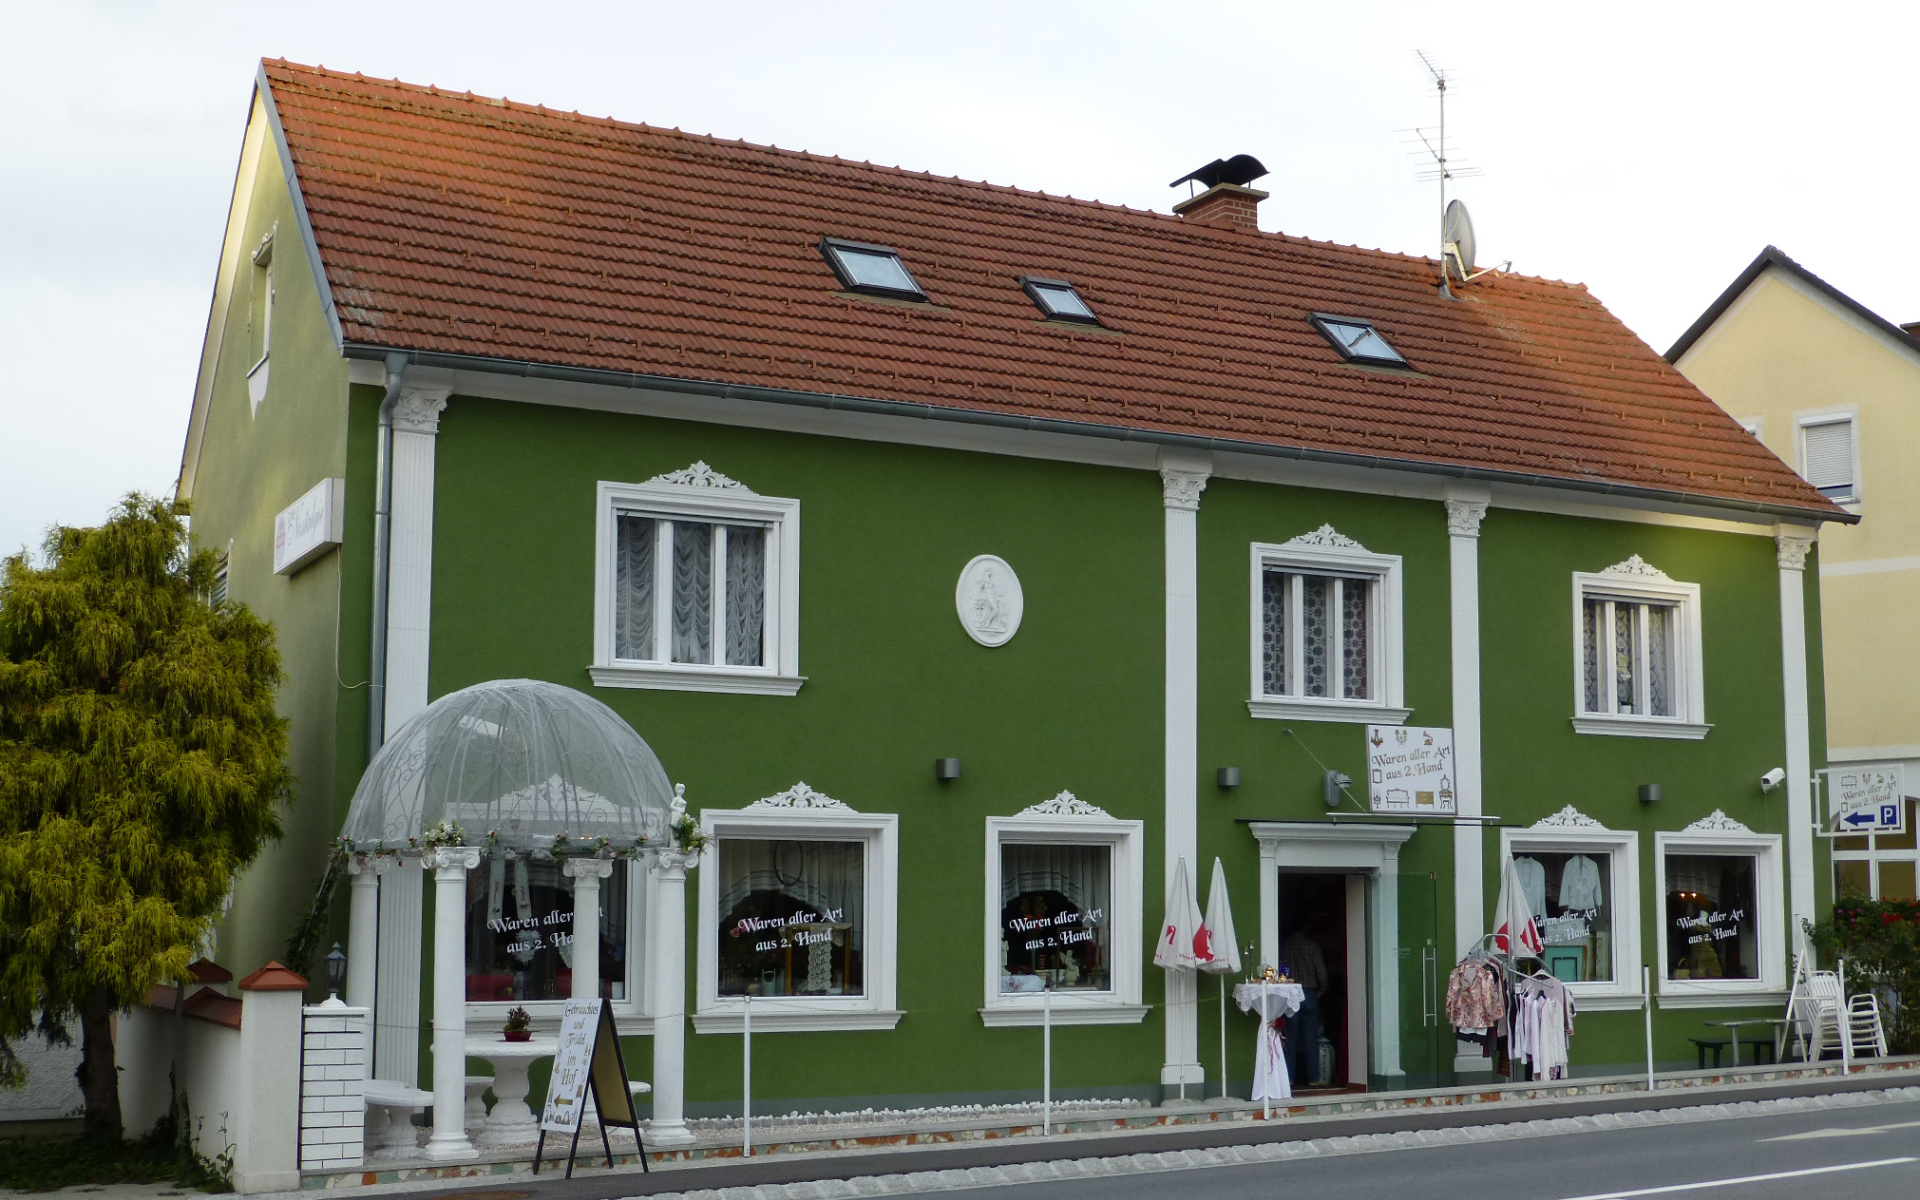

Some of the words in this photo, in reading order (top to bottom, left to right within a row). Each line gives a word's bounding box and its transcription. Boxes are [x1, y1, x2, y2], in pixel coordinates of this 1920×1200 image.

[1371, 754, 1408, 767] Waren
[1409, 748, 1431, 761] aller
[1434, 745, 1451, 759] Art
[1386, 771, 1402, 780] aus
[1404, 765, 1416, 777] 2.
[1416, 759, 1443, 775] Hand
[1840, 791, 1865, 801] Waren
[1867, 784, 1882, 794] aller
[1884, 780, 1897, 791] Art
[1871, 790, 1891, 804] Hand
[1883, 807, 1893, 824] P
[487, 917, 539, 934] Waren
[543, 910, 574, 925] aller
[737, 917, 785, 933] Waren
[788, 910, 816, 925] aller
[820, 907, 843, 923] Art
[1009, 917, 1051, 933] Waren
[1054, 911, 1079, 925] aller
[1082, 907, 1103, 923] Art
[1559, 910, 1579, 923] aller
[1582, 908, 1598, 921] Art
[1676, 916, 1708, 930] Waren
[1708, 911, 1727, 923] aller
[1729, 908, 1744, 921] Art
[507, 940, 530, 953] aus
[534, 940, 547, 950] 2.
[549, 932, 574, 947] Ha
[755, 940, 778, 952] aus
[780, 939, 792, 948] 2.
[794, 928, 832, 946] Hand
[1025, 939, 1045, 950] aus
[1047, 938, 1057, 947] 2.
[1060, 927, 1093, 945] Hand
[1541, 934, 1553, 944] us
[1554, 934, 1563, 942] 2.
[1564, 924, 1590, 940] Hand
[1688, 934, 1703, 944] aus
[1704, 933, 1712, 941] 2.
[1712, 924, 1738, 940] Hand
[561, 1068, 579, 1091] Hof
